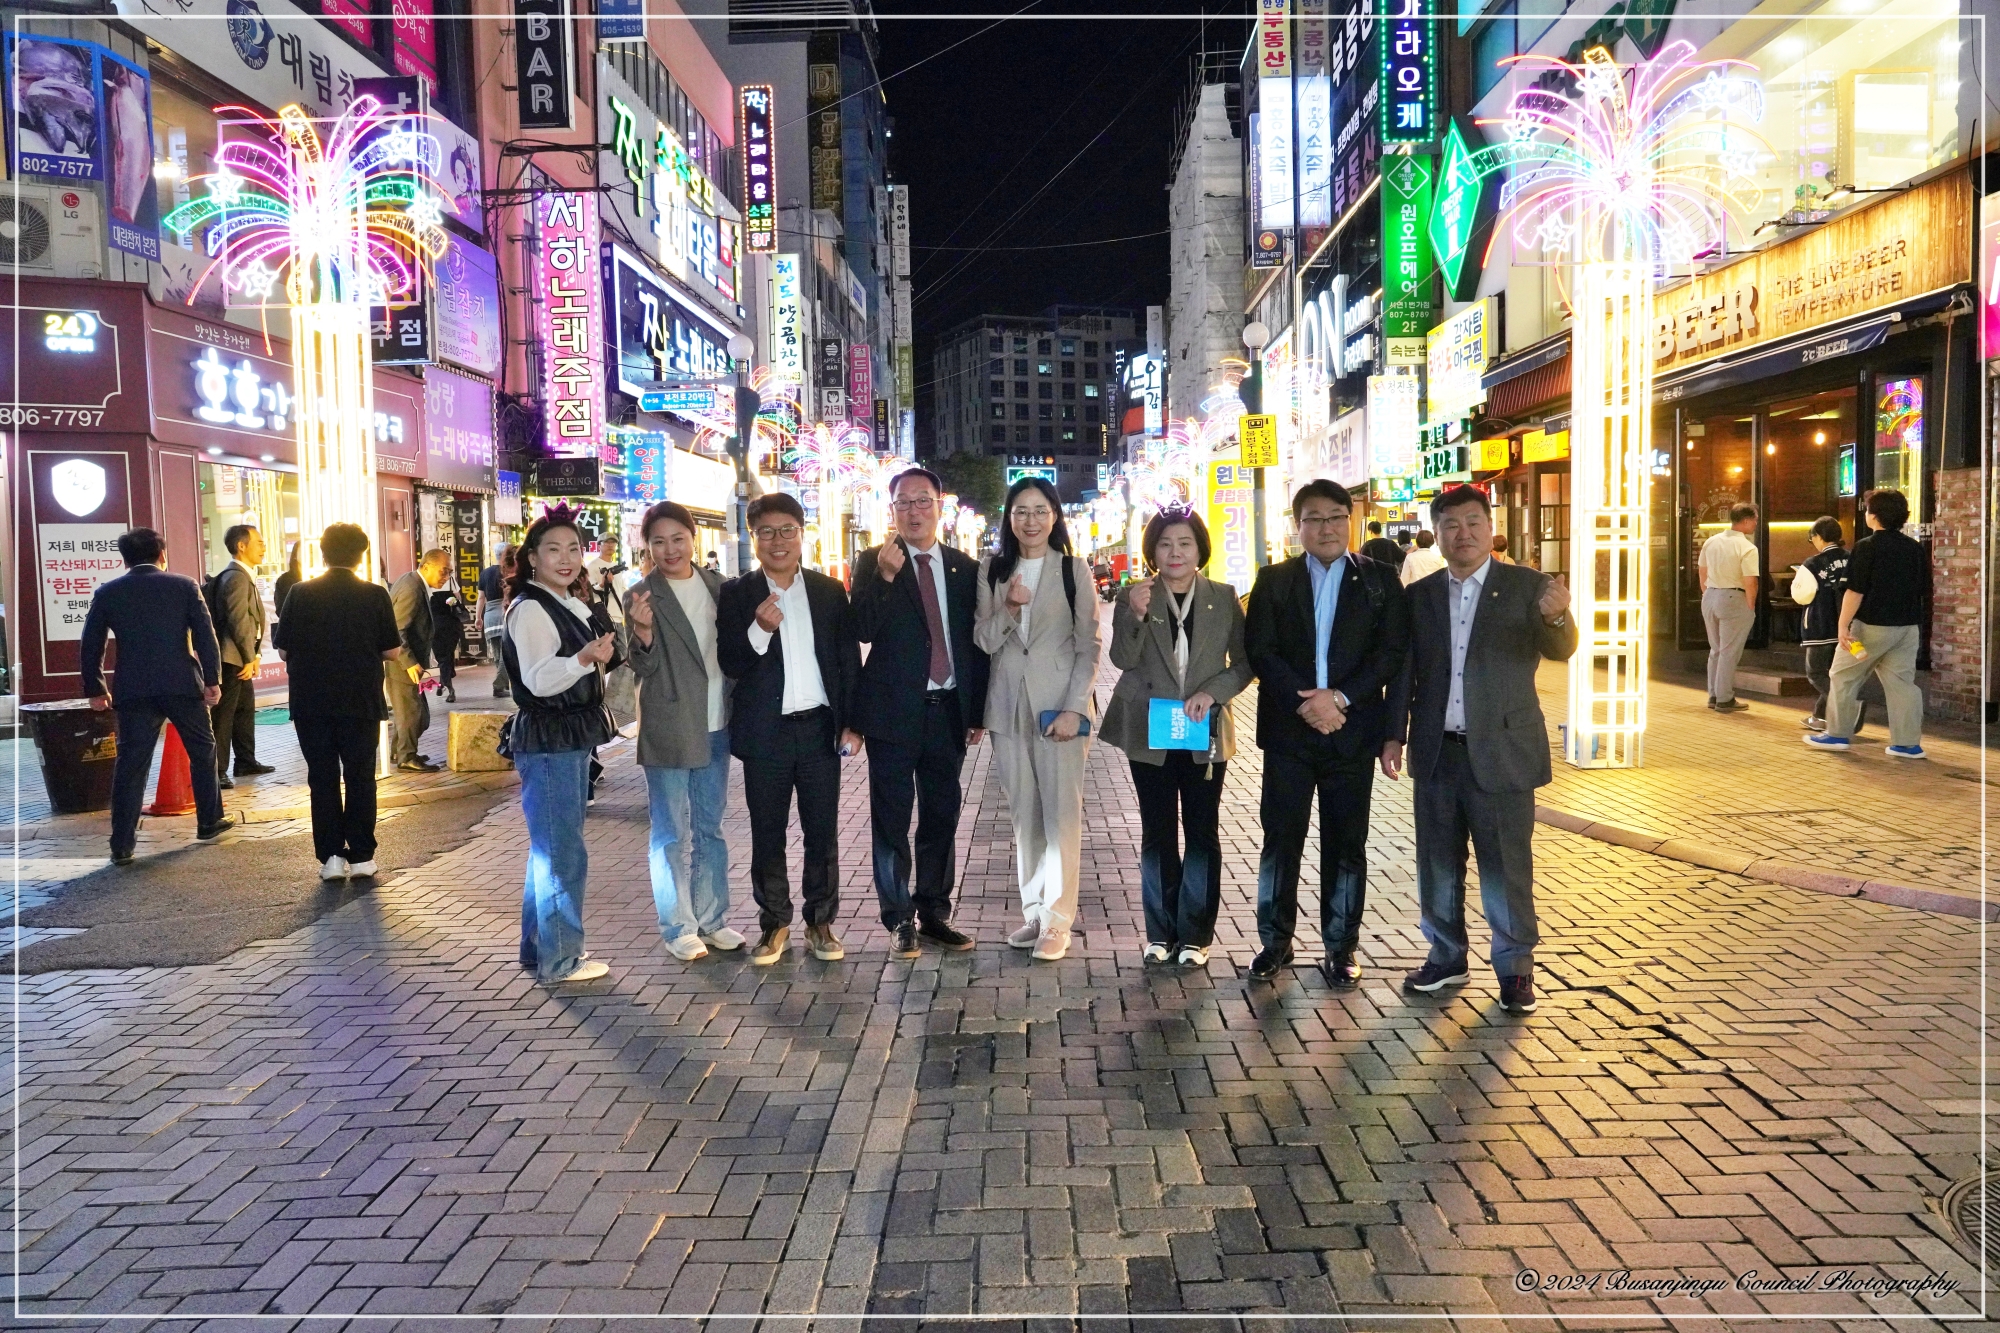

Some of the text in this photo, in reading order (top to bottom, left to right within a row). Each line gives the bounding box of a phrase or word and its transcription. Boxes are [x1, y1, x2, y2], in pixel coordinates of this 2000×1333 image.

[602, 25, 642, 34] 805-1539
[1263, 12, 1286, 68] 부동산
[1332, 0, 1374, 87] 부동산
[248, 56, 265, 69] TUNA
[526, 11, 554, 114] BAR
[1395, 0, 1423, 128] 가라오케
[22, 156, 94, 178] 802-7577
[63, 210, 79, 219] LG
[749, 204, 772, 217] 소주
[1444, 204, 1461, 229] HAIR
[749, 218, 773, 232] 호프
[113, 226, 157, 257] 대림참치 본점
[751, 232, 771, 248] 3F
[1389, 311, 1430, 319] 807-8789
[1652, 285, 1757, 361] BEER
[46, 315, 81, 336] 24
[195, 324, 220, 343] 맛있는
[1302, 274, 1346, 385] ON
[1402, 321, 1418, 333] 2F
[1453, 308, 1483, 345] 감자탕
[47, 338, 95, 352] OPEN
[1453, 337, 1482, 370] 아구찜
[1816, 338, 1849, 357] BEER
[851, 347, 869, 406] 월드마사지
[1388, 380, 1415, 394] 청진동
[427, 379, 456, 417] 낭랑
[0, 408, 104, 427] 806-7797
[824, 404, 843, 416] 치킨
[429, 422, 492, 466] 노래방주점
[629, 435, 644, 446] A6
[387, 458, 417, 474] 806-7797
[634, 448, 660, 499] 양곱창
[544, 476, 592, 486] THE KING
[1373, 490, 1412, 500] 가라오케
[439, 504, 455, 516] 학원
[48, 540, 119, 553] 저희 매장은
[439, 532, 453, 543] 4F
